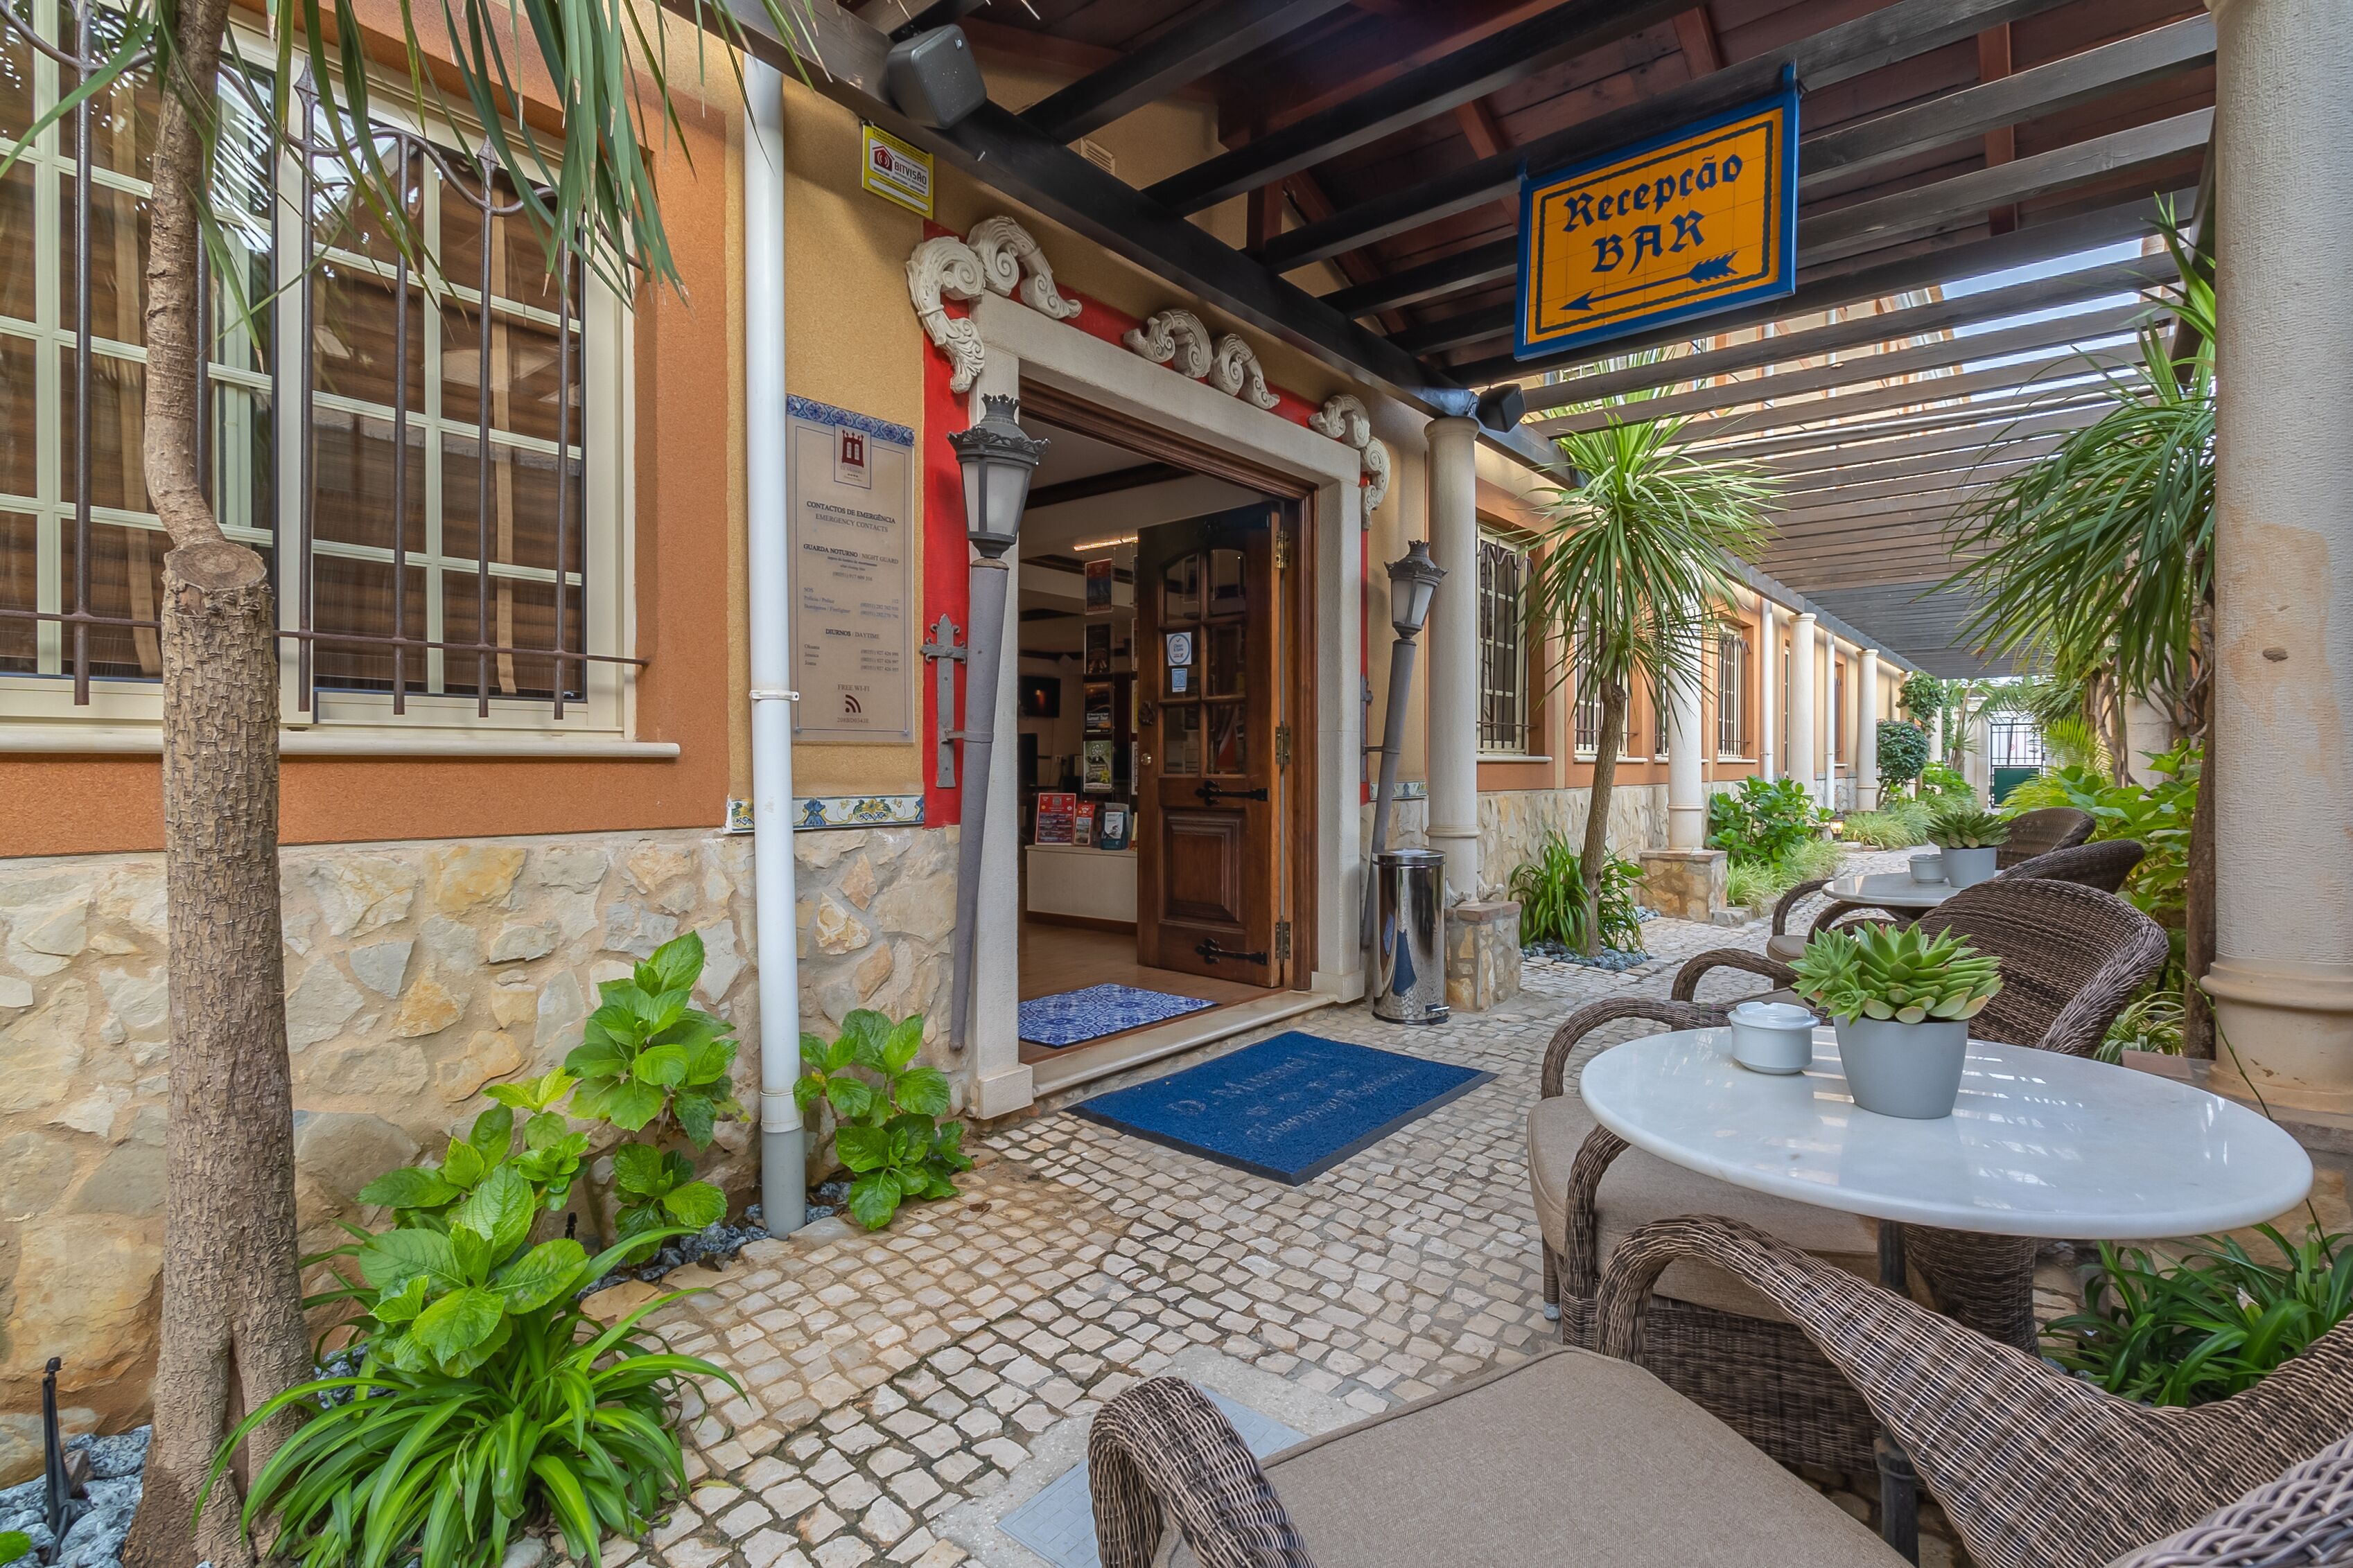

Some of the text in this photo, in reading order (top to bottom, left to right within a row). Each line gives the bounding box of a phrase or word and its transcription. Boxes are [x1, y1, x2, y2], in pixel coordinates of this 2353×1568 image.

[894, 161, 927, 185] BITVISÃO
[1562, 154, 1743, 233] Recepção
[1591, 209, 1706, 275] BAR
[807, 500, 846, 514] CONTACTOS
[857, 511, 895, 524] EMERGÊNCIA
[816, 513, 888, 532] EMERGENCY CONTACTS
[803, 543, 829, 552] GUARDA
[830, 548, 858, 558] NOTURNO
[825, 628, 851, 637] DIURNOS
